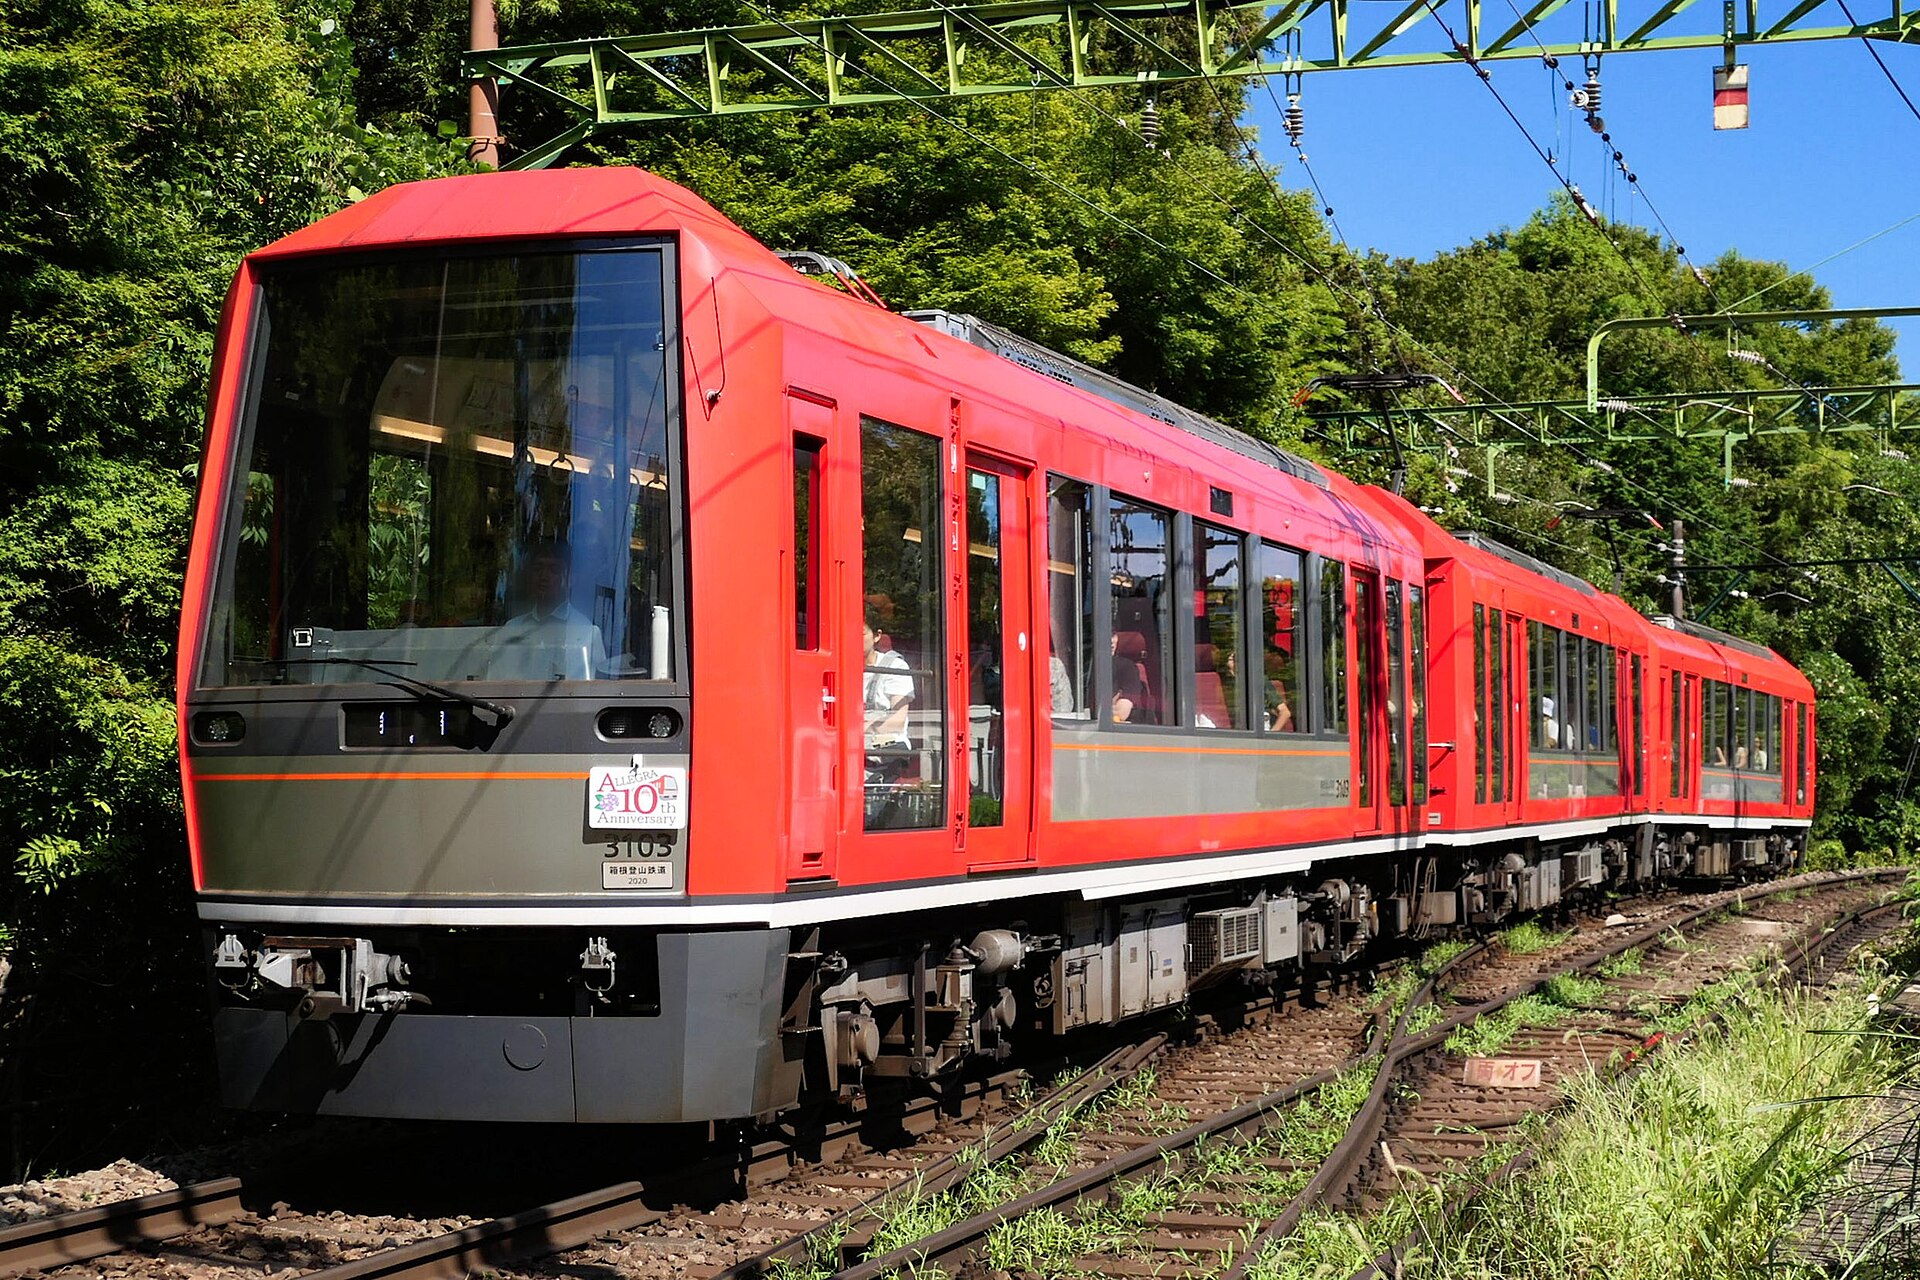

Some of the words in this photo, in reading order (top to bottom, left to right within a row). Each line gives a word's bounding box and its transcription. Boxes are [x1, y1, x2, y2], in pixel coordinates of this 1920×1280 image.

[596, 770, 659, 792] ALLEGRA
[597, 811, 677, 826] Anniversary
[604, 833, 672, 858] 3103
[609, 865, 667, 875] 箱根登山鉄道
[628, 877, 648, 885] 2020
